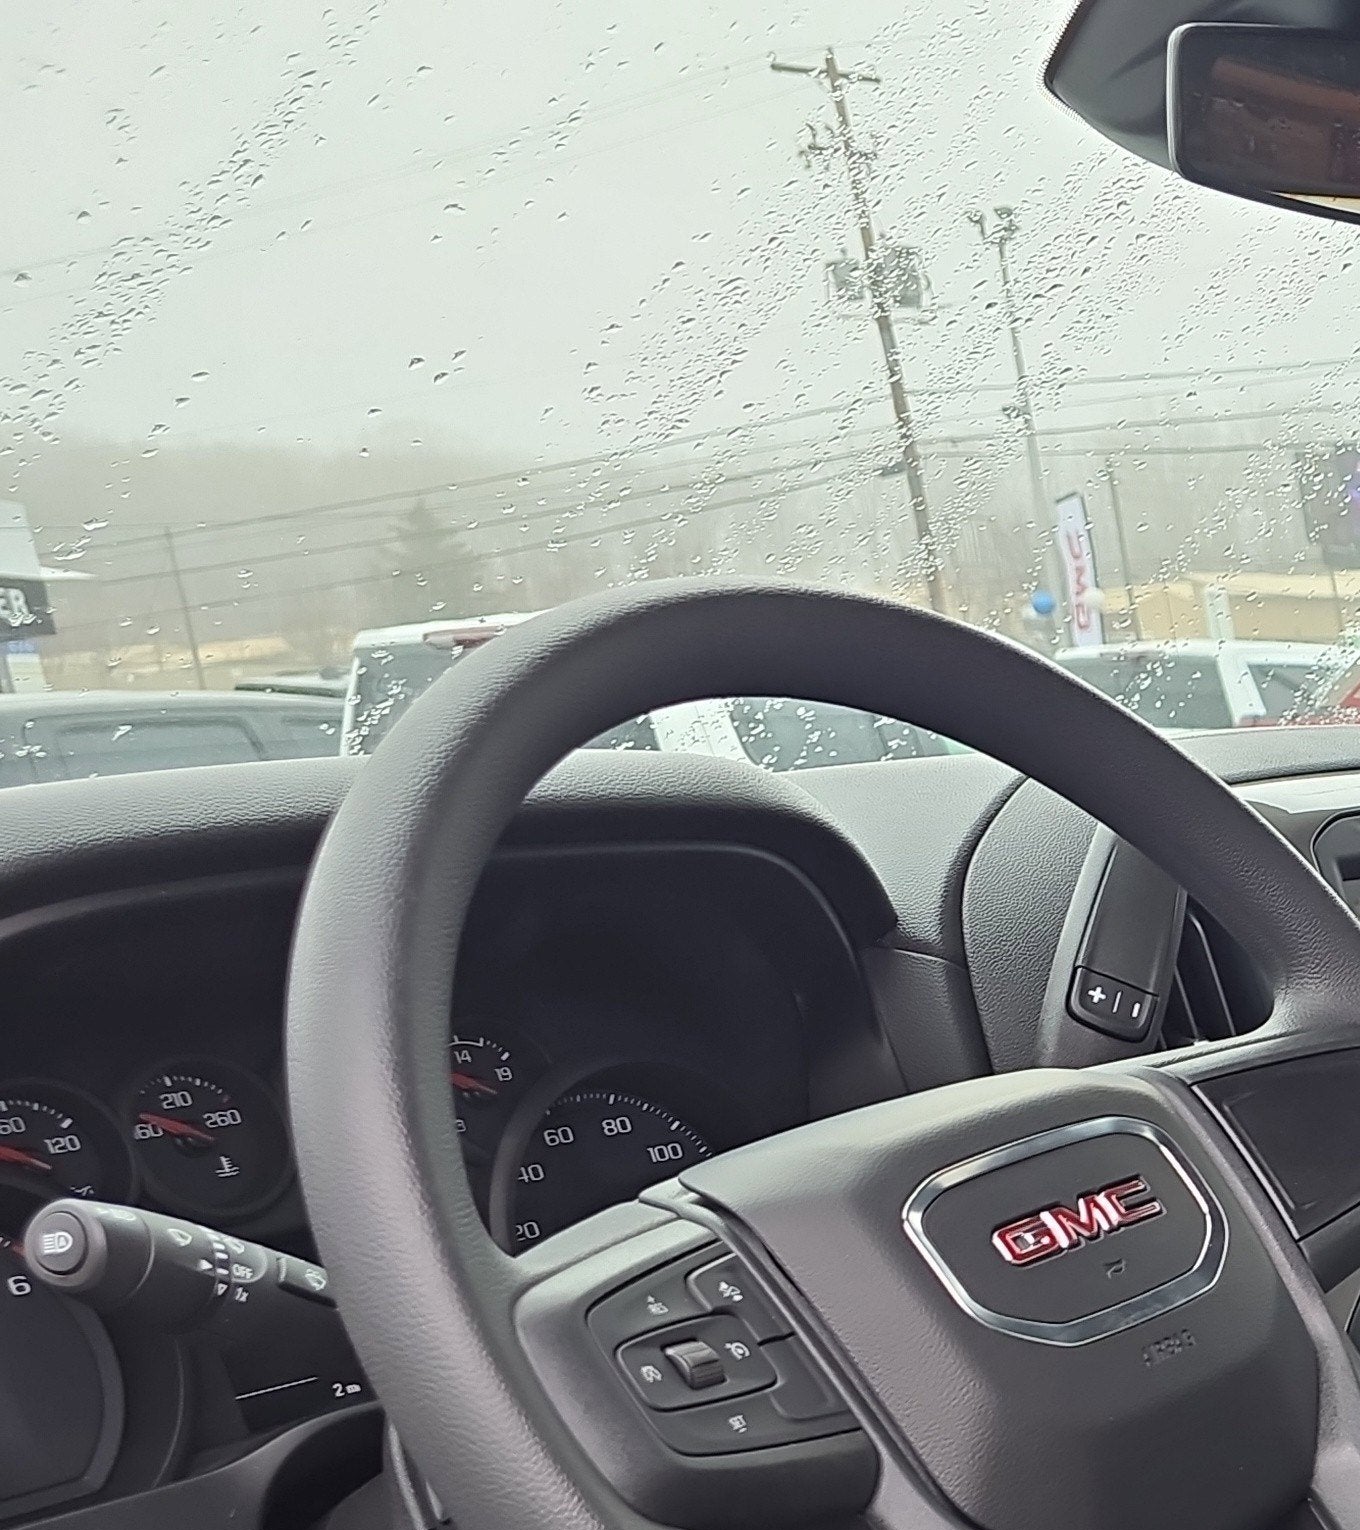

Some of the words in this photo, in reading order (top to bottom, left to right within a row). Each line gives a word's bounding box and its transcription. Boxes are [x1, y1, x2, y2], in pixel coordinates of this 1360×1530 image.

[453, 1050, 472, 1065] 14
[494, 1066, 513, 1081] 19
[159, 1091, 194, 1110] 210
[203, 1109, 244, 1129] 260
[601, 1116, 633, 1137] 80
[43, 1134, 81, 1154] 120
[543, 1125, 575, 1147] 60
[646, 1143, 684, 1163] 100
[517, 1162, 545, 1183] 40
[515, 1221, 541, 1242] 20
[992, 1178, 1164, 1265] GMC
[231, 1263, 254, 1280] OFF
[7, 1276, 33, 1298] 6
[233, 1286, 249, 1303] 1x
[332, 1382, 345, 1397] 2
